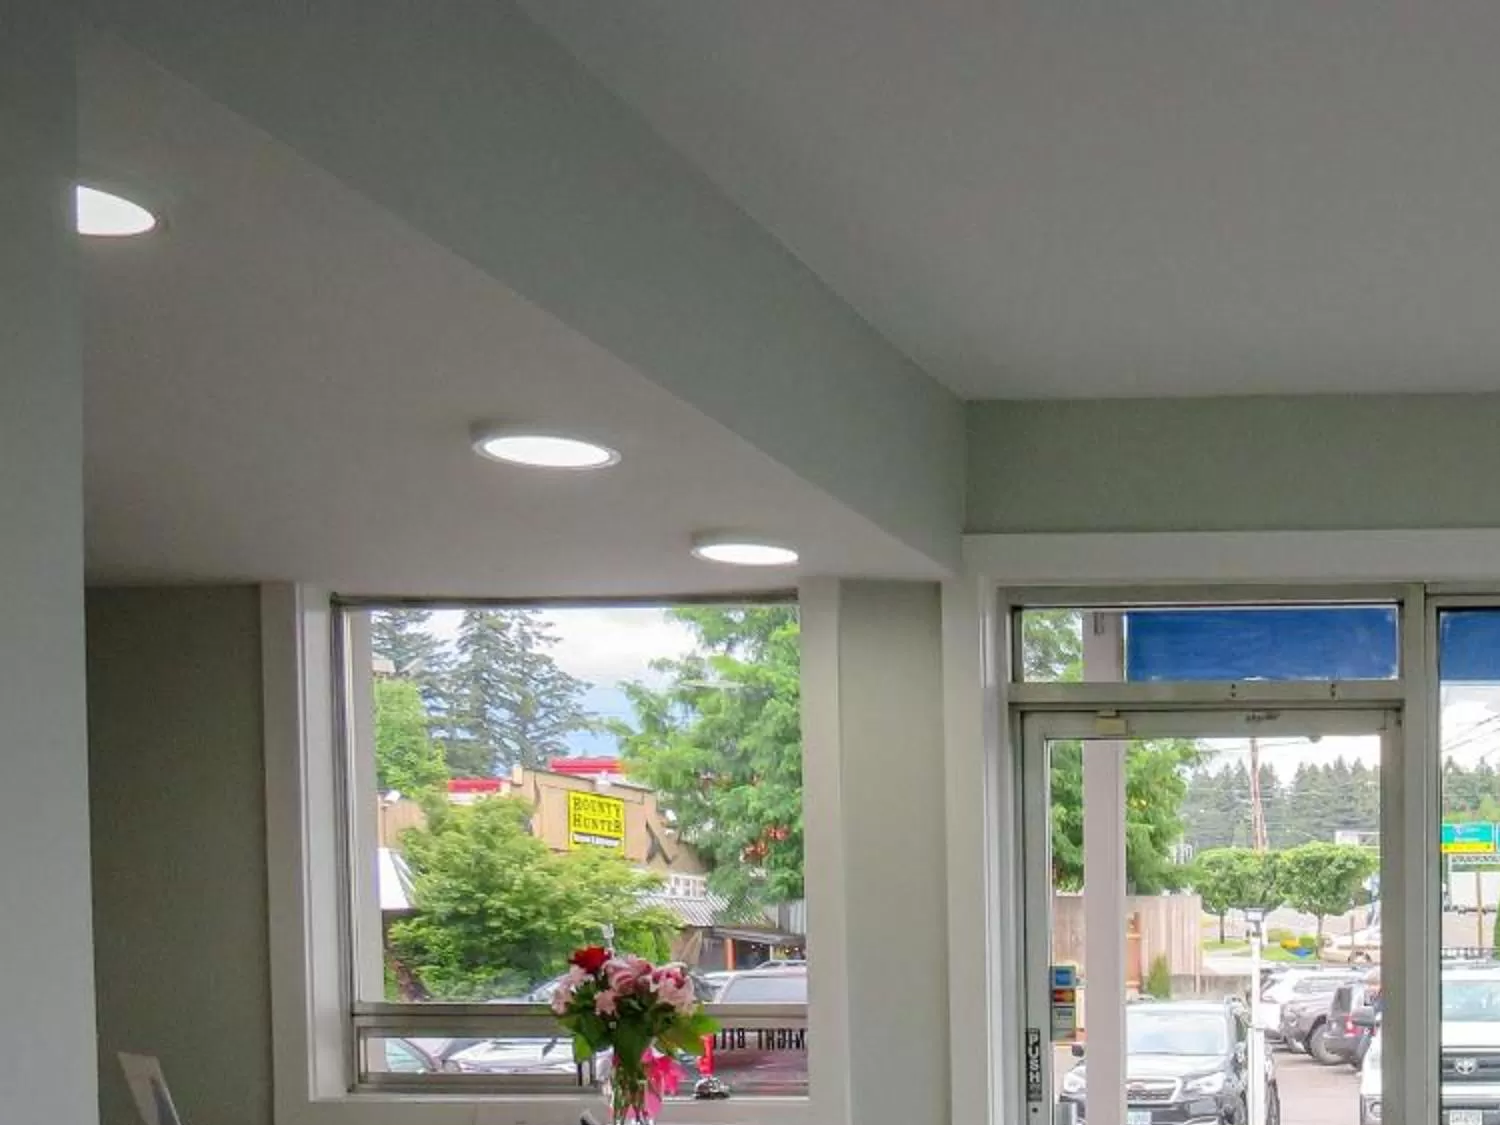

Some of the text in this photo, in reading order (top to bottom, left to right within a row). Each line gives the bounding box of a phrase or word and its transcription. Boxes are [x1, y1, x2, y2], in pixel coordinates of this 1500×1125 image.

[572, 796, 621, 818] BOUNTY
[572, 813, 622, 834] HUNTER
[1028, 1033, 1040, 1083] PUSH
